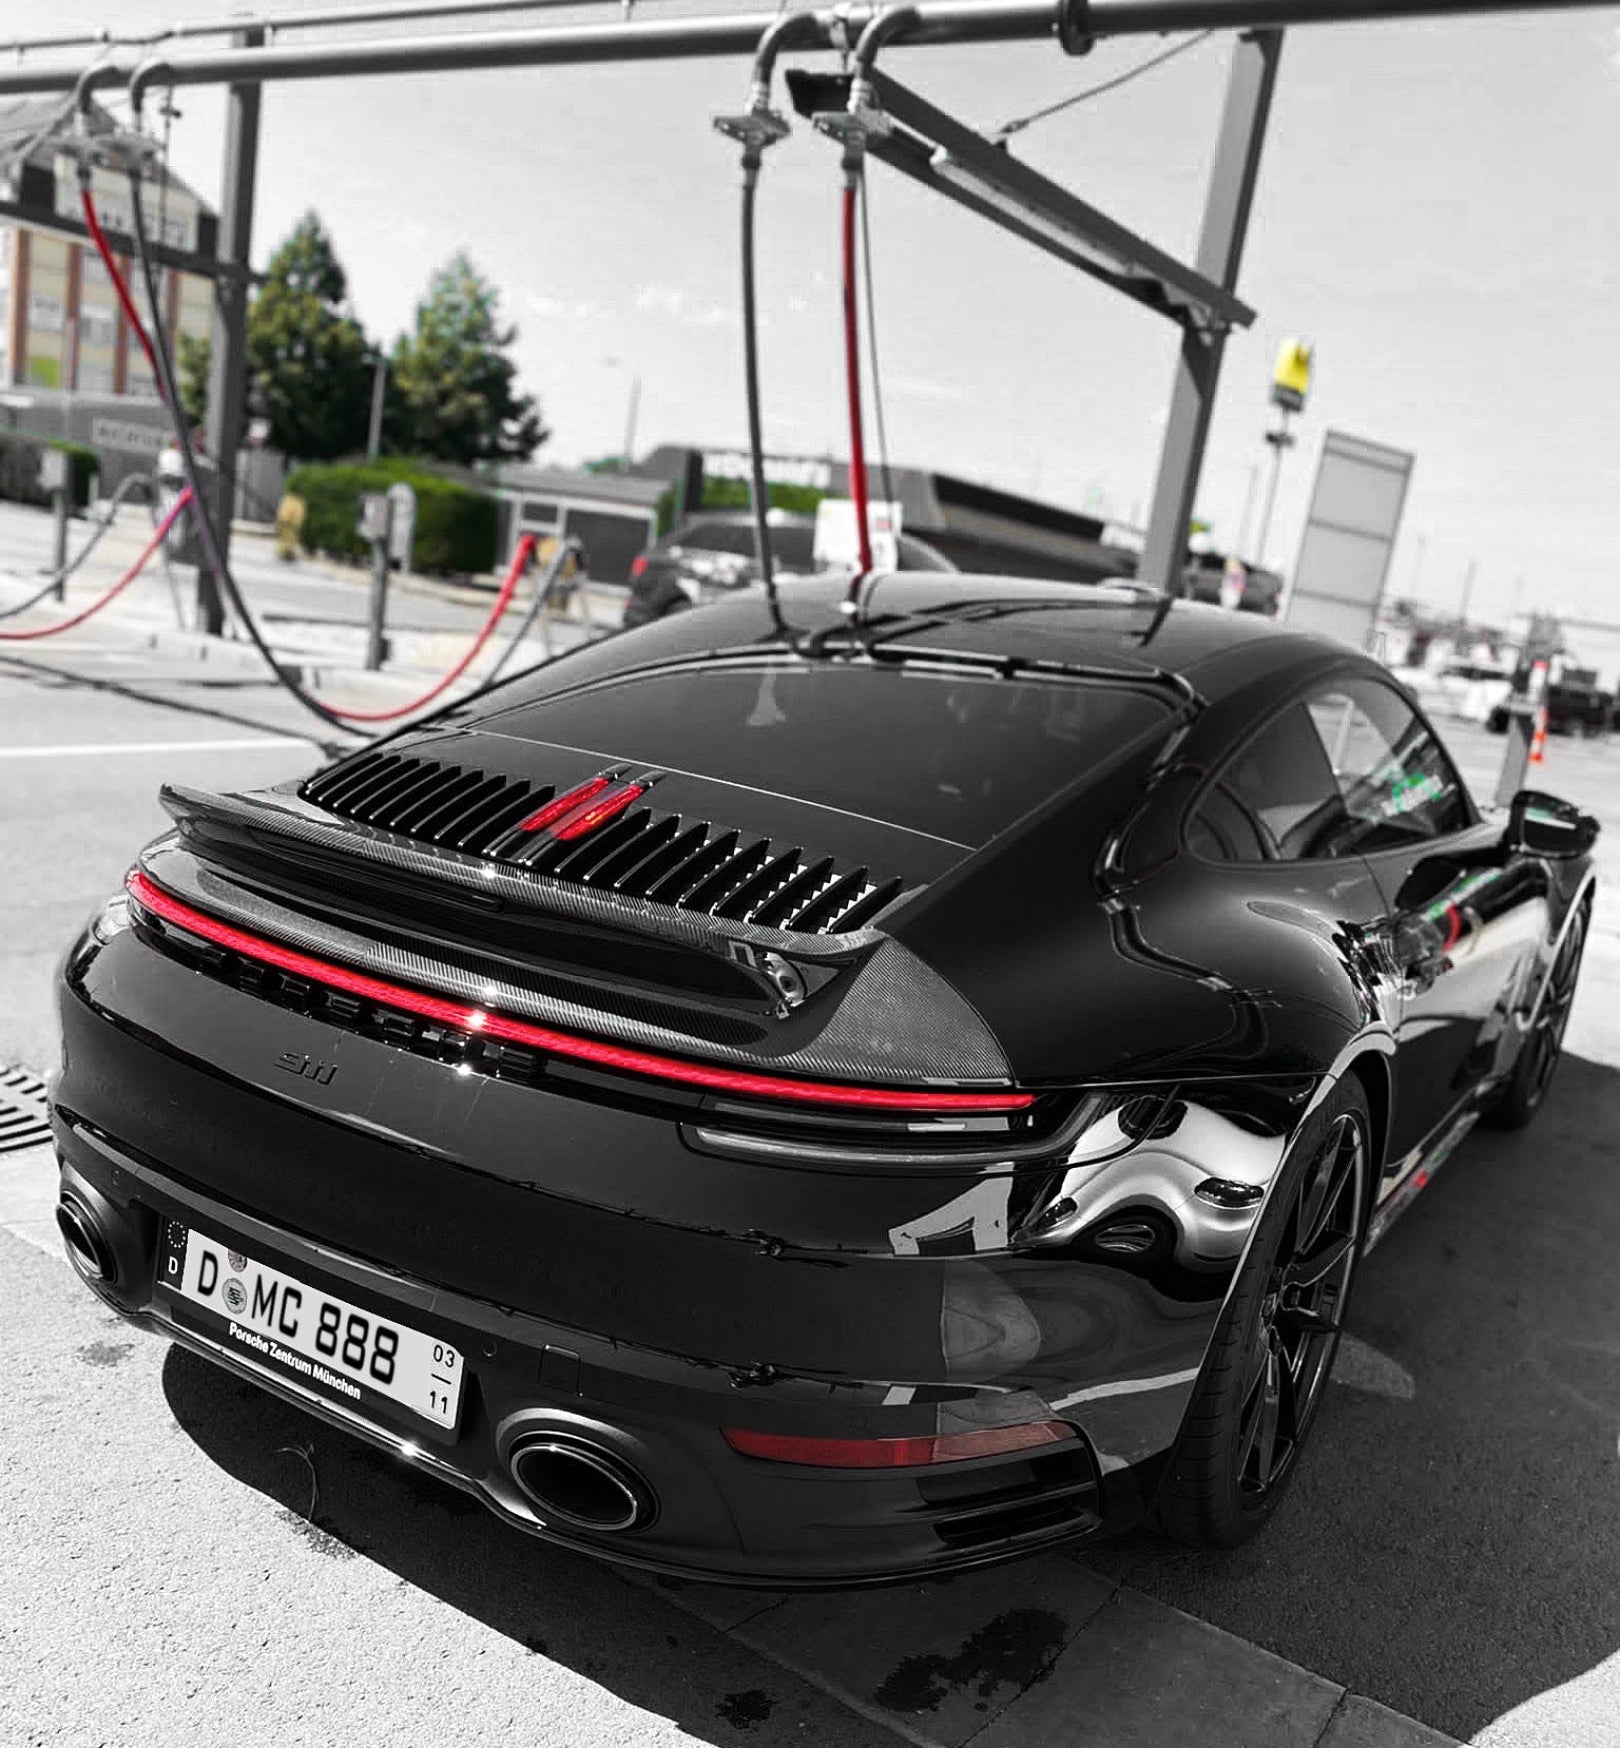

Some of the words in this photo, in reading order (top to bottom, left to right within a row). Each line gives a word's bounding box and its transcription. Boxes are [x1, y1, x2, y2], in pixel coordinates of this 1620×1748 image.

[272, 1050, 338, 1086] 911
[168, 1256, 178, 1274] D
[197, 1250, 219, 1296] D
[251, 1273, 303, 1338] MC
[315, 1302, 399, 1385] 888
[229, 1322, 269, 1354] Porsche
[269, 1341, 312, 1376] Zentrum
[312, 1364, 361, 1400] München
[433, 1344, 455, 1368] 03
[429, 1391, 448, 1414] 11
